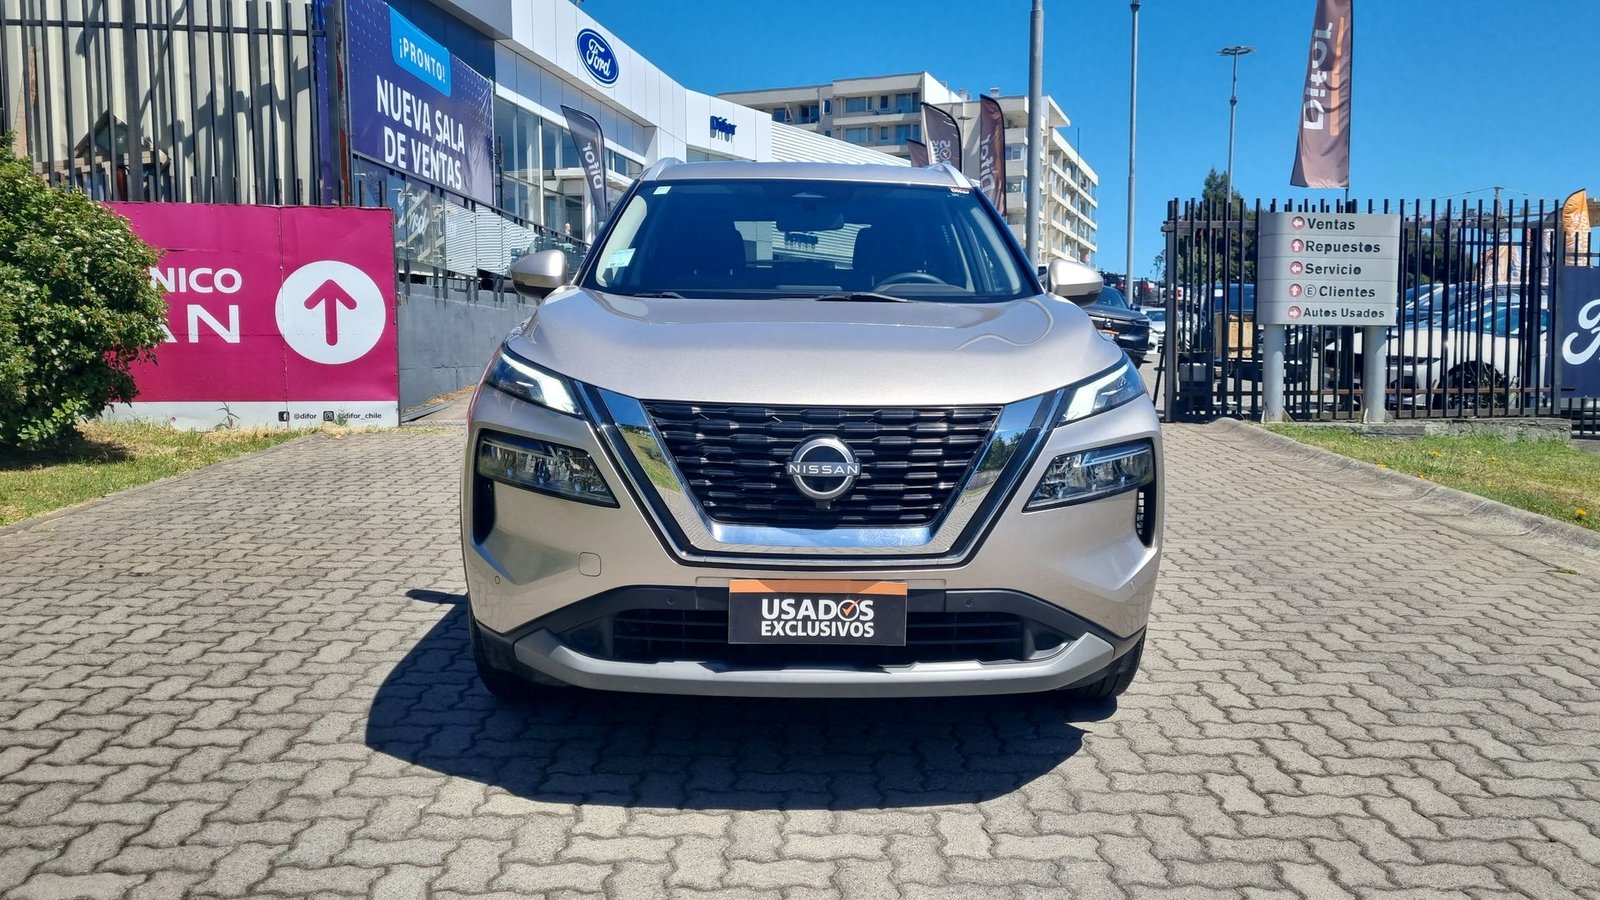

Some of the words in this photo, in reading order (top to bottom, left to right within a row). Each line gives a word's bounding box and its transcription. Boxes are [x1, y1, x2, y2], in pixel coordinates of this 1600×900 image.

[399, 37, 446, 84] ¡PRONTO!
[586, 38, 611, 77] Ford
[376, 74, 432, 138] NUEVA
[435, 109, 466, 155] SALA
[383, 125, 408, 170] DE
[411, 138, 463, 191] VENTAS
[1307, 218, 1355, 231] Ventas
[1305, 240, 1381, 254] Repuestos
[1305, 263, 1361, 275] Servicio
[149, 266, 242, 293] NICO
[1319, 286, 1376, 298] Clientes
[1303, 307, 1337, 318] Autos
[1341, 308, 1385, 318] Usados
[157, 304, 240, 343] N
[293, 412, 317, 420] @difor
[789, 464, 858, 474] NISSAN
[761, 598, 875, 621] USADOS
[761, 620, 875, 638] EXCLUSIVOS
